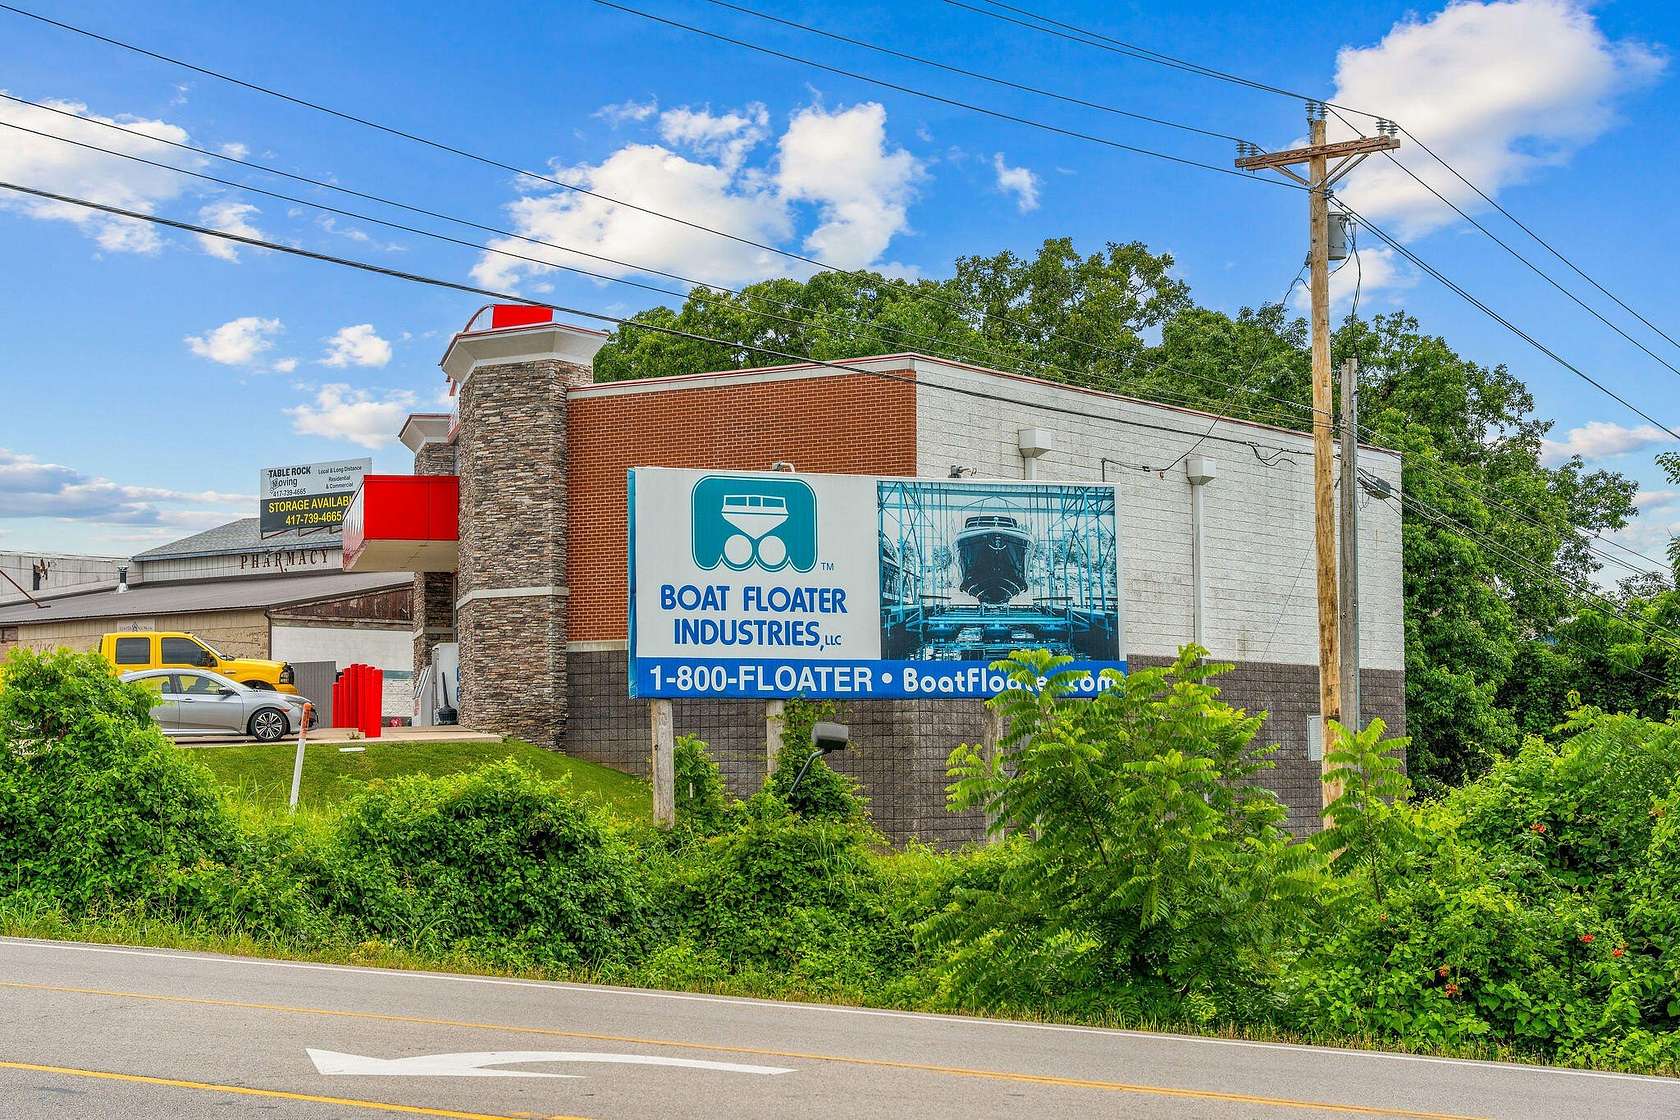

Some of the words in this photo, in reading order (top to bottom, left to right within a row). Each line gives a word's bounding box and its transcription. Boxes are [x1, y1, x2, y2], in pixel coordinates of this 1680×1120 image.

[268, 468, 291, 478] TABLE
[291, 466, 312, 476] ROCK
[333, 466, 344, 474] Long
[271, 477, 298, 488] Moving
[328, 474, 351, 482] Residential
[330, 481, 354, 489] Commercial
[268, 499, 310, 513] STORAGE
[285, 510, 342, 526] 417-739-4665
[240, 549, 328, 574] PHARMACY
[820, 562, 834, 571] TM
[660, 584, 730, 611] BOAT
[743, 586, 848, 613] FLOATER
[674, 618, 824, 651] INDUSTRIES,
[824, 634, 842, 646] LLC
[649, 665, 873, 692] 1-800-FLOATER
